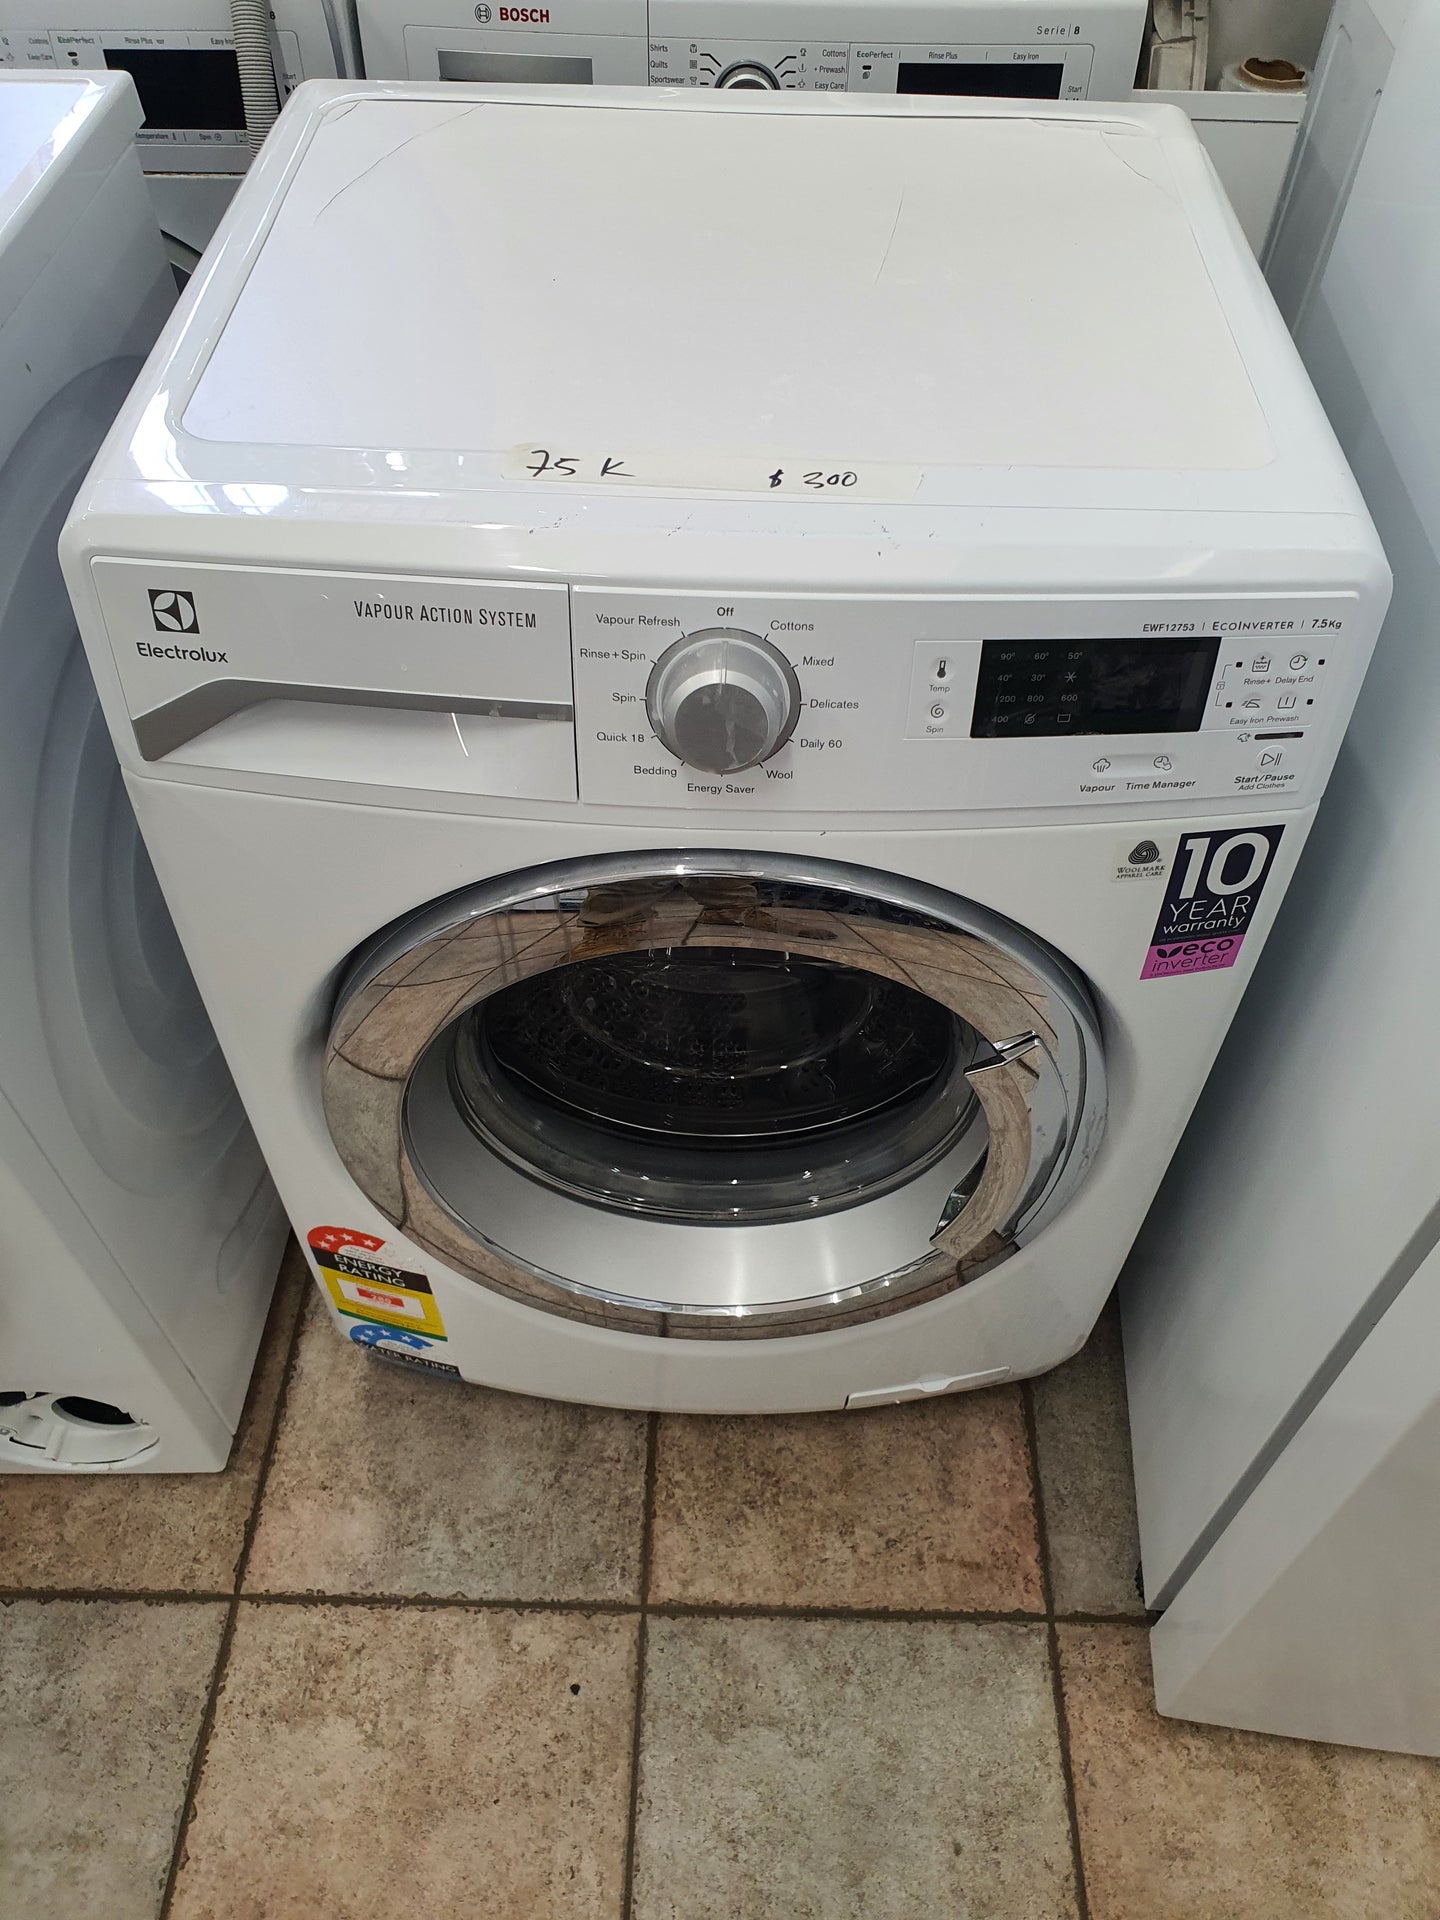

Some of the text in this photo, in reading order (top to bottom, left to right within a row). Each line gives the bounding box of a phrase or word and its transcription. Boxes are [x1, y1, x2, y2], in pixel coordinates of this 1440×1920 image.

[500, 8, 549, 23] BOSCH
[1036, 25, 1066, 35] Serie
[650, 44, 668, 52] Shirts
[822, 49, 847, 57] Cottons
[856, 51, 893, 59] EcoPerfect
[928, 52, 958, 60] Rinse Plus
[1013, 52, 1040, 61] Easy Iron
[650, 60, 668, 69] Quilts
[819, 66, 846, 74] Prewash
[650, 76, 685, 85] Sportswear
[814, 81, 845, 90] Easy Care
[1067, 85, 1083, 93] Start
[526, 450, 581, 478] 75
[803, 471, 858, 489] 300
[354, 601, 537, 628] VAPOUR ACTION SYSTEM
[717, 607, 734, 616] Off
[596, 613, 681, 627] Vapour Refresh
[770, 620, 814, 631] Cottons
[1143, 623, 1195, 632] EWF12753
[1311, 619, 1342, 630] 7.5Kg
[136, 642, 229, 664] Electrolux
[802, 656, 834, 667] Mixed
[1275, 676, 1297, 685] Delay
[929, 684, 951, 693] Temp
[612, 692, 637, 704] Spin
[995, 694, 1078, 703] 1200 800 600
[809, 699, 859, 710] Delicates
[1229, 717, 1248, 726] Easy
[1266, 715, 1300, 723] Prewash
[925, 725, 944, 734] Spin
[596, 731, 645, 742] Quick 18
[800, 739, 843, 750] Daily 60
[633, 766, 677, 777] Bedding
[766, 770, 793, 780] Wool
[1234, 774, 1295, 784] Start/Pause
[687, 783, 755, 795] Energy Saver
[1079, 784, 1116, 794] Vapour
[1126, 780, 1197, 790] Time Manager
[1256, 782, 1285, 790] Clothes
[1117, 865, 1166, 874] WOOLMARK
[1179, 832, 1270, 900] 10
[1170, 895, 1251, 922] YEAR
[1163, 914, 1245, 935] warranty
[1183, 938, 1235, 956] eco
[1152, 951, 1229, 972] inverter
[334, 1253, 402, 1278] ENERGY
[339, 1263, 406, 1288] RATING
[405, 1355, 457, 1373] RATING
